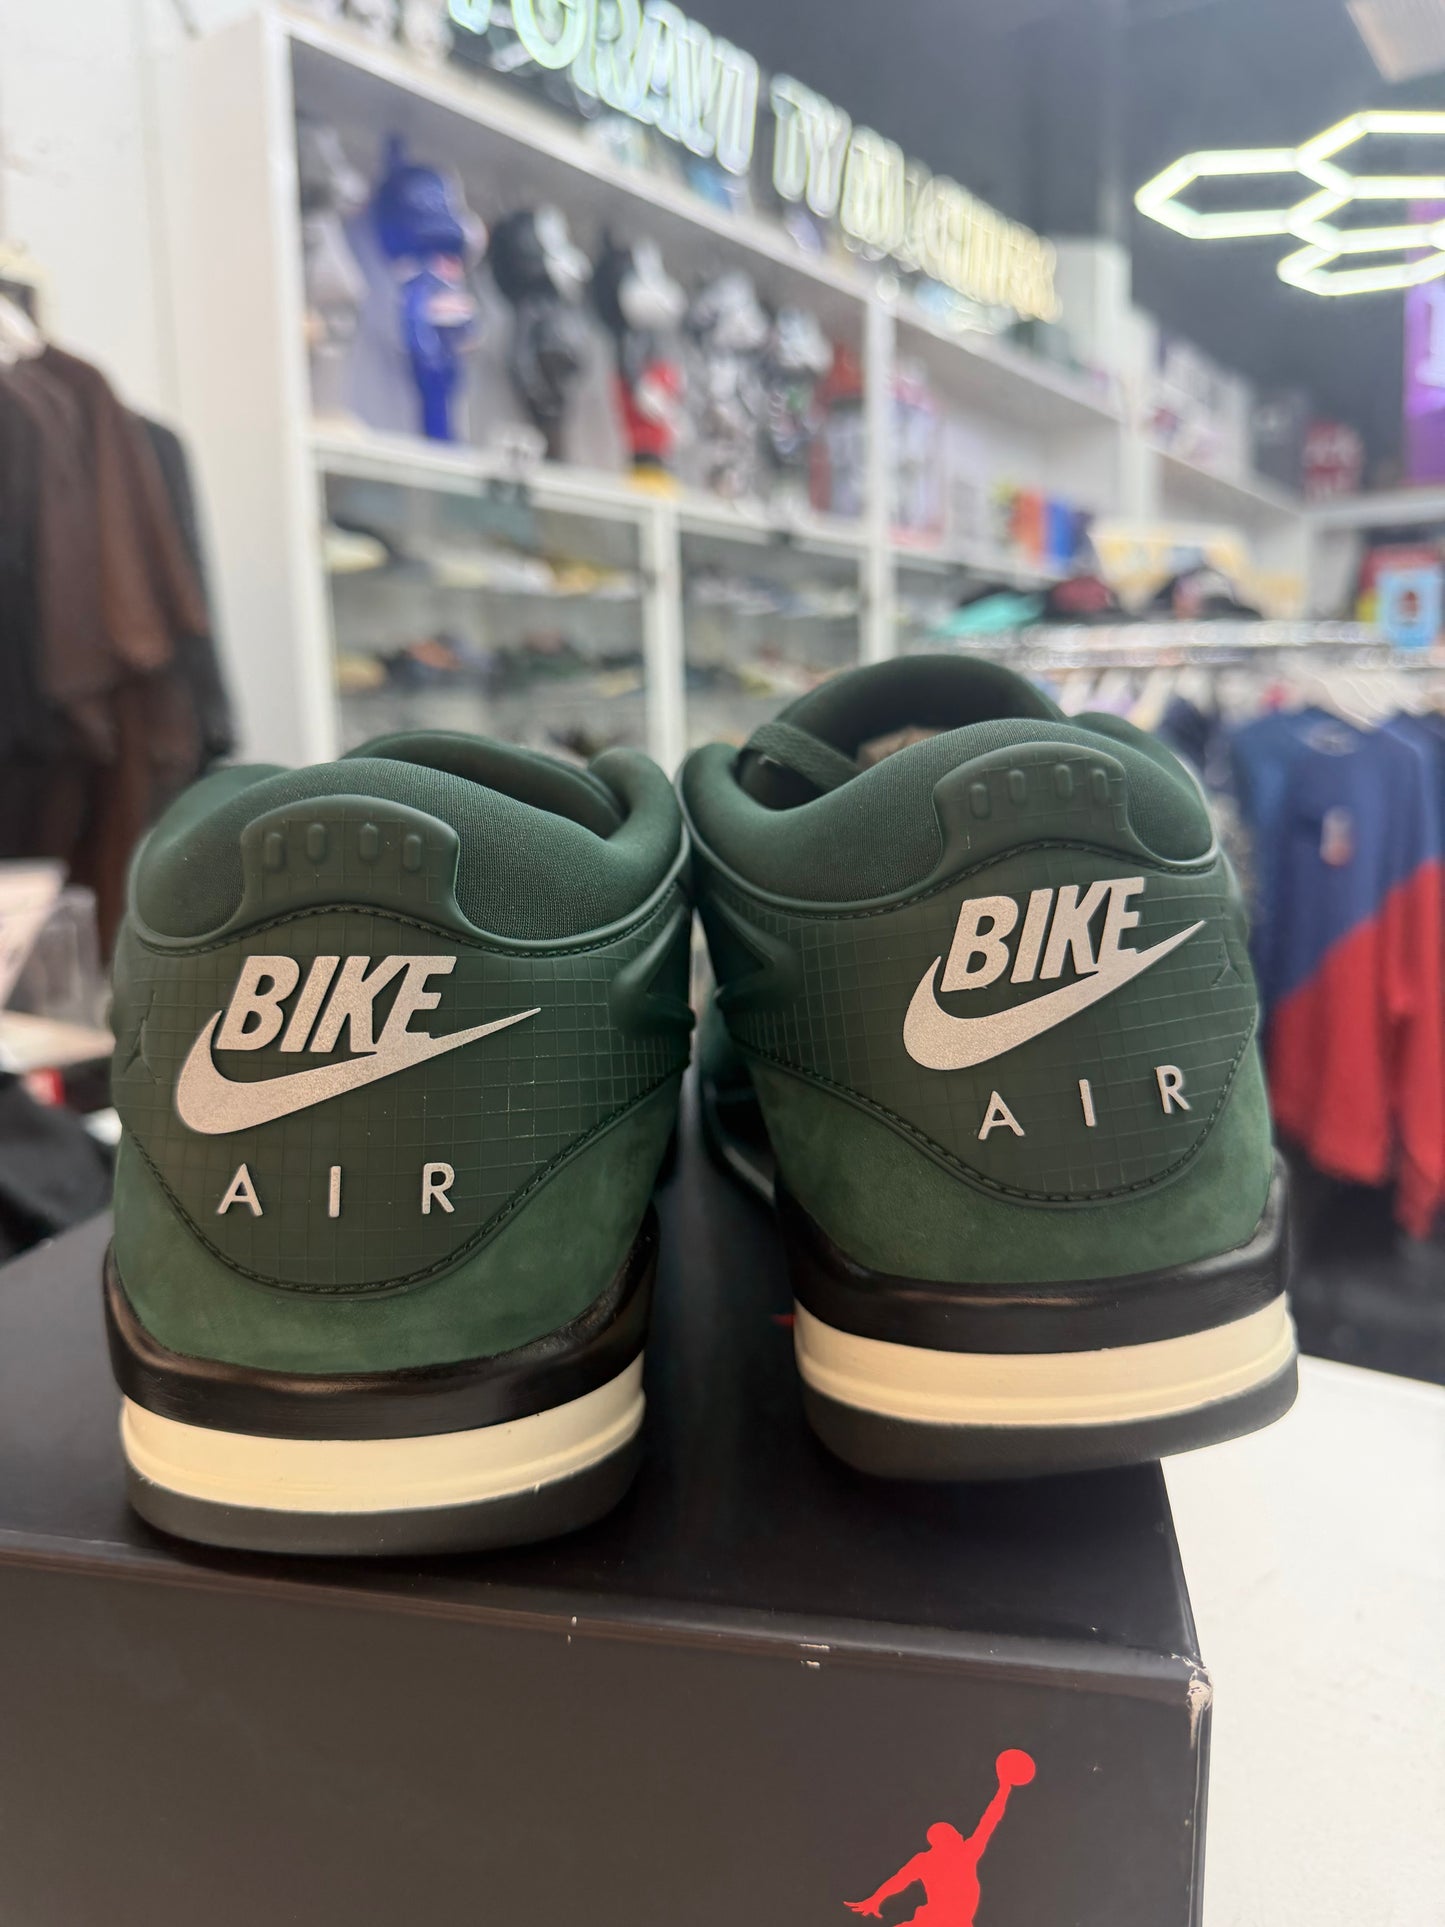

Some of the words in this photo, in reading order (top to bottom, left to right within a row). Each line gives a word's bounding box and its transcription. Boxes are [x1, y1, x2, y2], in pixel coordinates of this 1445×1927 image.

[940, 877, 1145, 992] BIKE
[215, 955, 457, 1053] BIKE
[976, 1064, 1191, 1140] AIR
[218, 1162, 455, 1218] AIR
